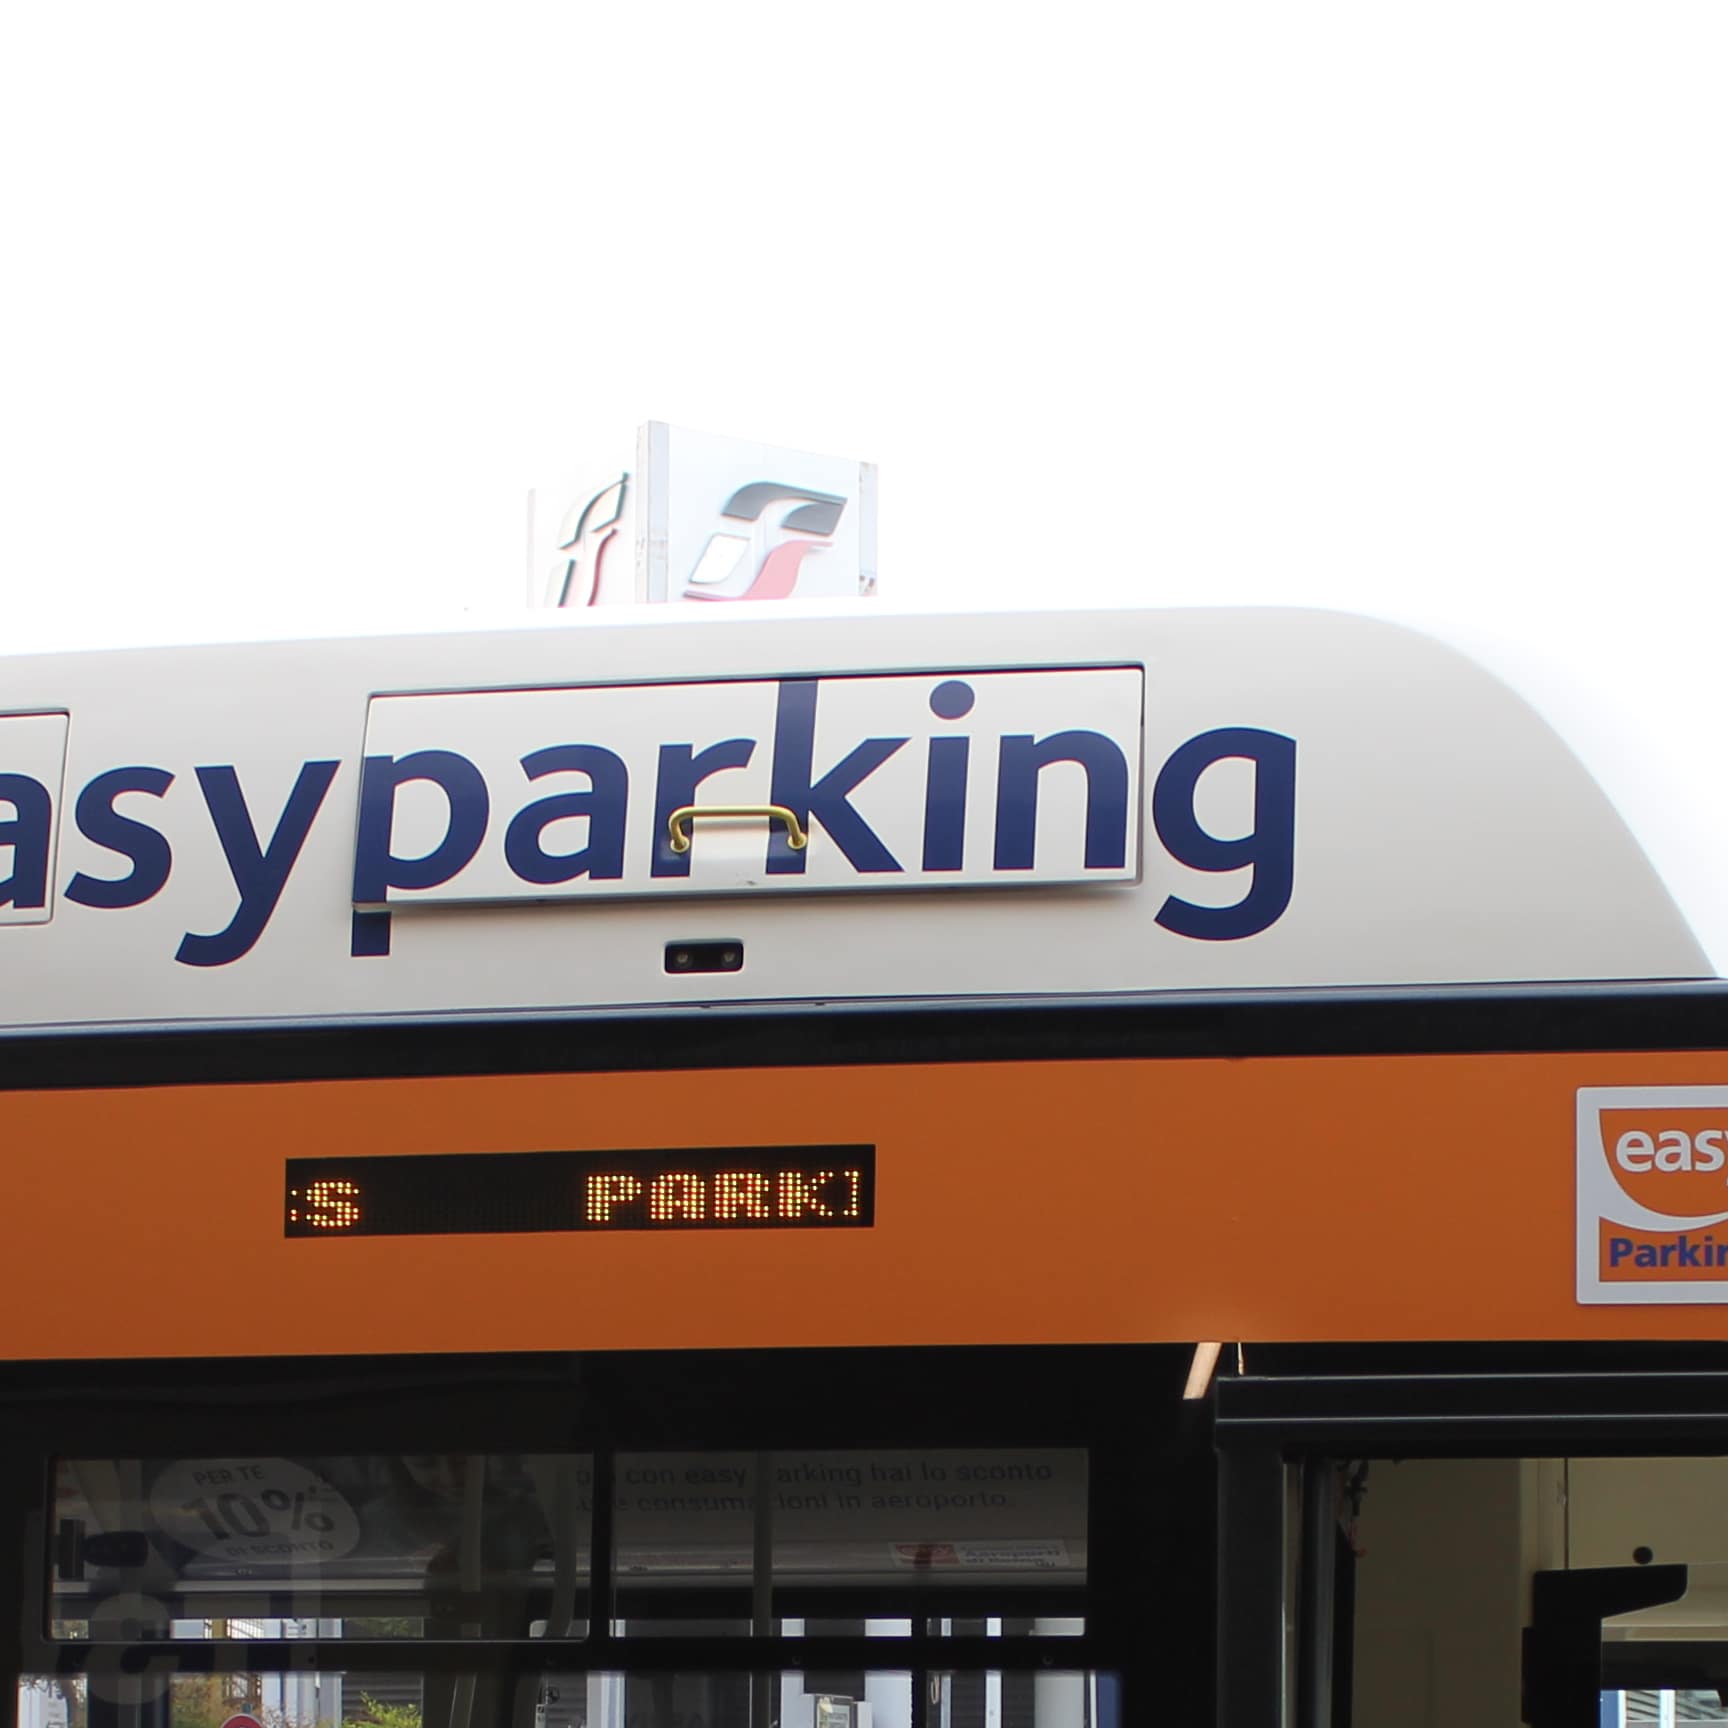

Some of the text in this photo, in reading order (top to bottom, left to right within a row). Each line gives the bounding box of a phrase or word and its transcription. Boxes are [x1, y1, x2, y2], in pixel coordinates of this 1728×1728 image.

[289, 1181, 361, 1228] S
[624, 1466, 675, 1485] con
[684, 1466, 747, 1488] easy
[774, 1461, 862, 1488] arking
[954, 1462, 1053, 1482] sconto
[181, 1488, 335, 1540] 10%
[871, 1489, 1008, 1512] aeroporto
